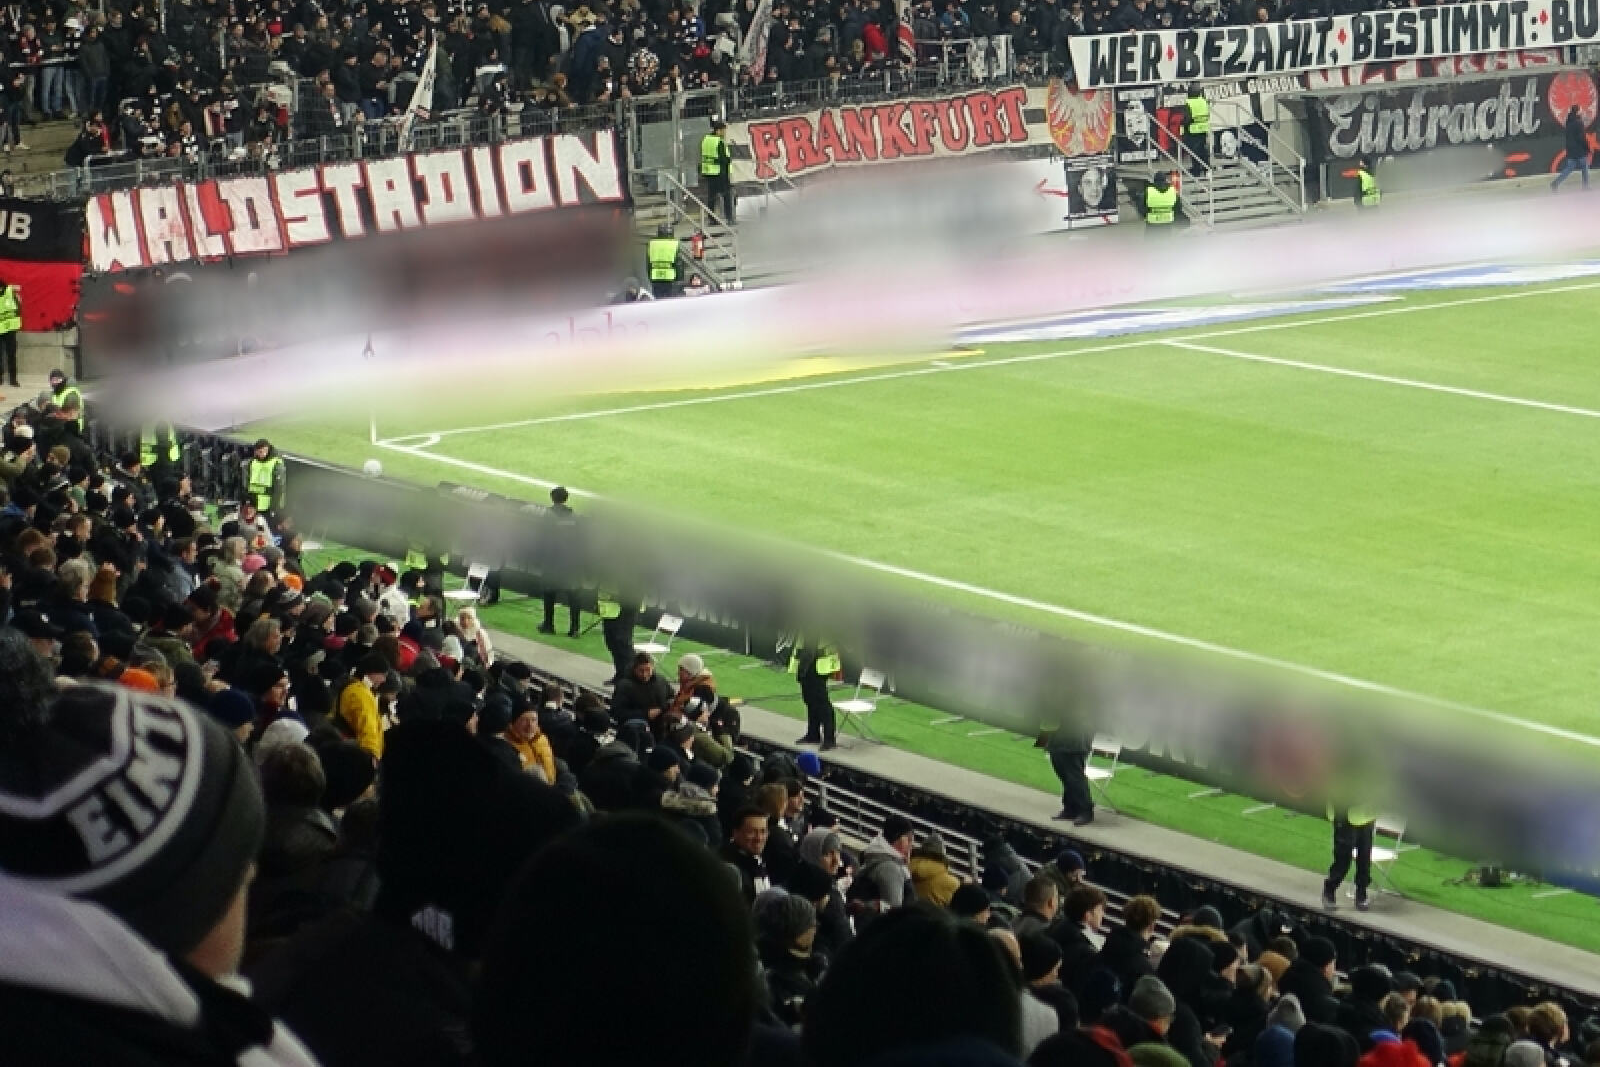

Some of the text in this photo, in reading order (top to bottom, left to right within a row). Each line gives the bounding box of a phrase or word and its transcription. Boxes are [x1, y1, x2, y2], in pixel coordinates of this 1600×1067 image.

[1089, 33, 1163, 87] WER
[1176, 18, 1339, 83] BEZAHLT,
[1351, 0, 1539, 61] BESTIMMT:
[748, 85, 1029, 181] FRANKFURT
[1325, 76, 1542, 158] Eintracht
[85, 129, 625, 274] WALDSTADION
